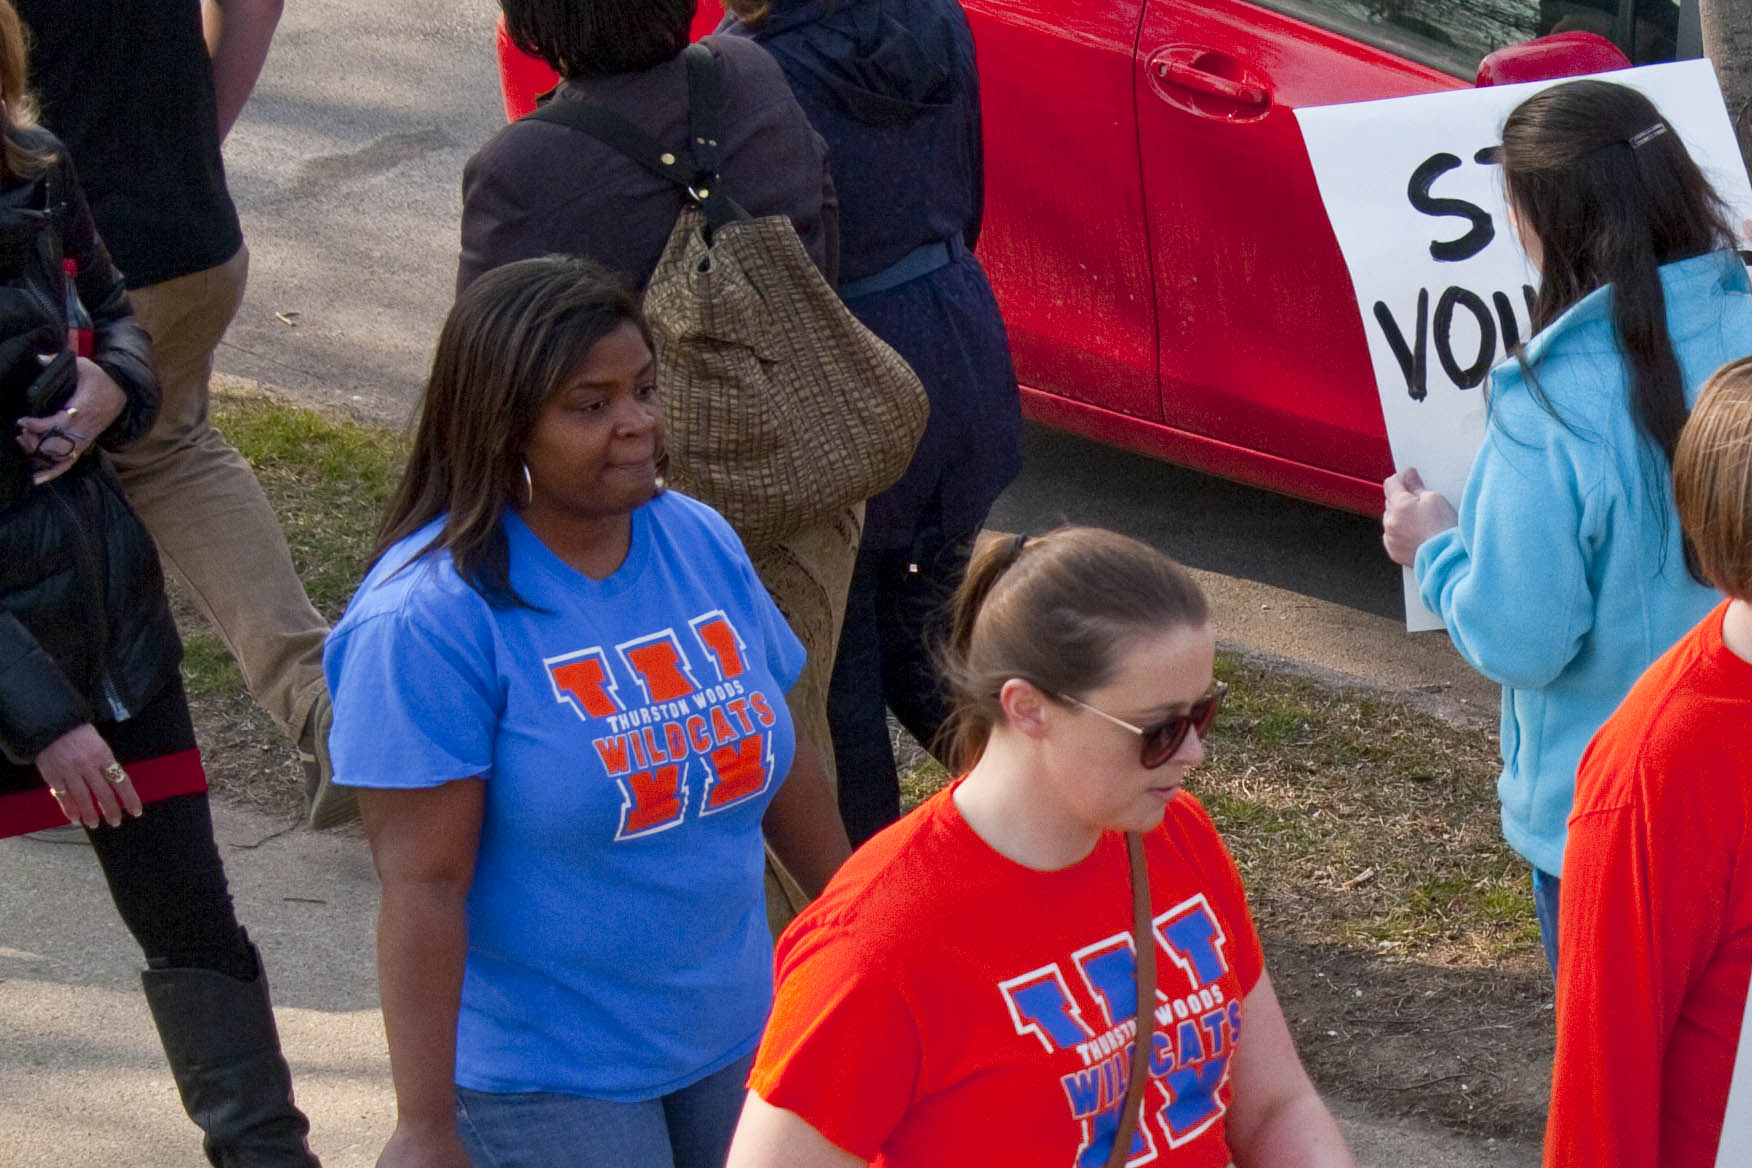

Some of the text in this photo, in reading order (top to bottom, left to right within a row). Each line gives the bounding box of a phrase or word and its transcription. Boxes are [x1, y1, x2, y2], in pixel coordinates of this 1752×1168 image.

[592, 690, 776, 777] WILDCATS
[606, 679, 744, 733] THURSTON WOODS
[1061, 998, 1242, 1119] WILCATS
[1076, 984, 1224, 1066] THURSTO WOODS
